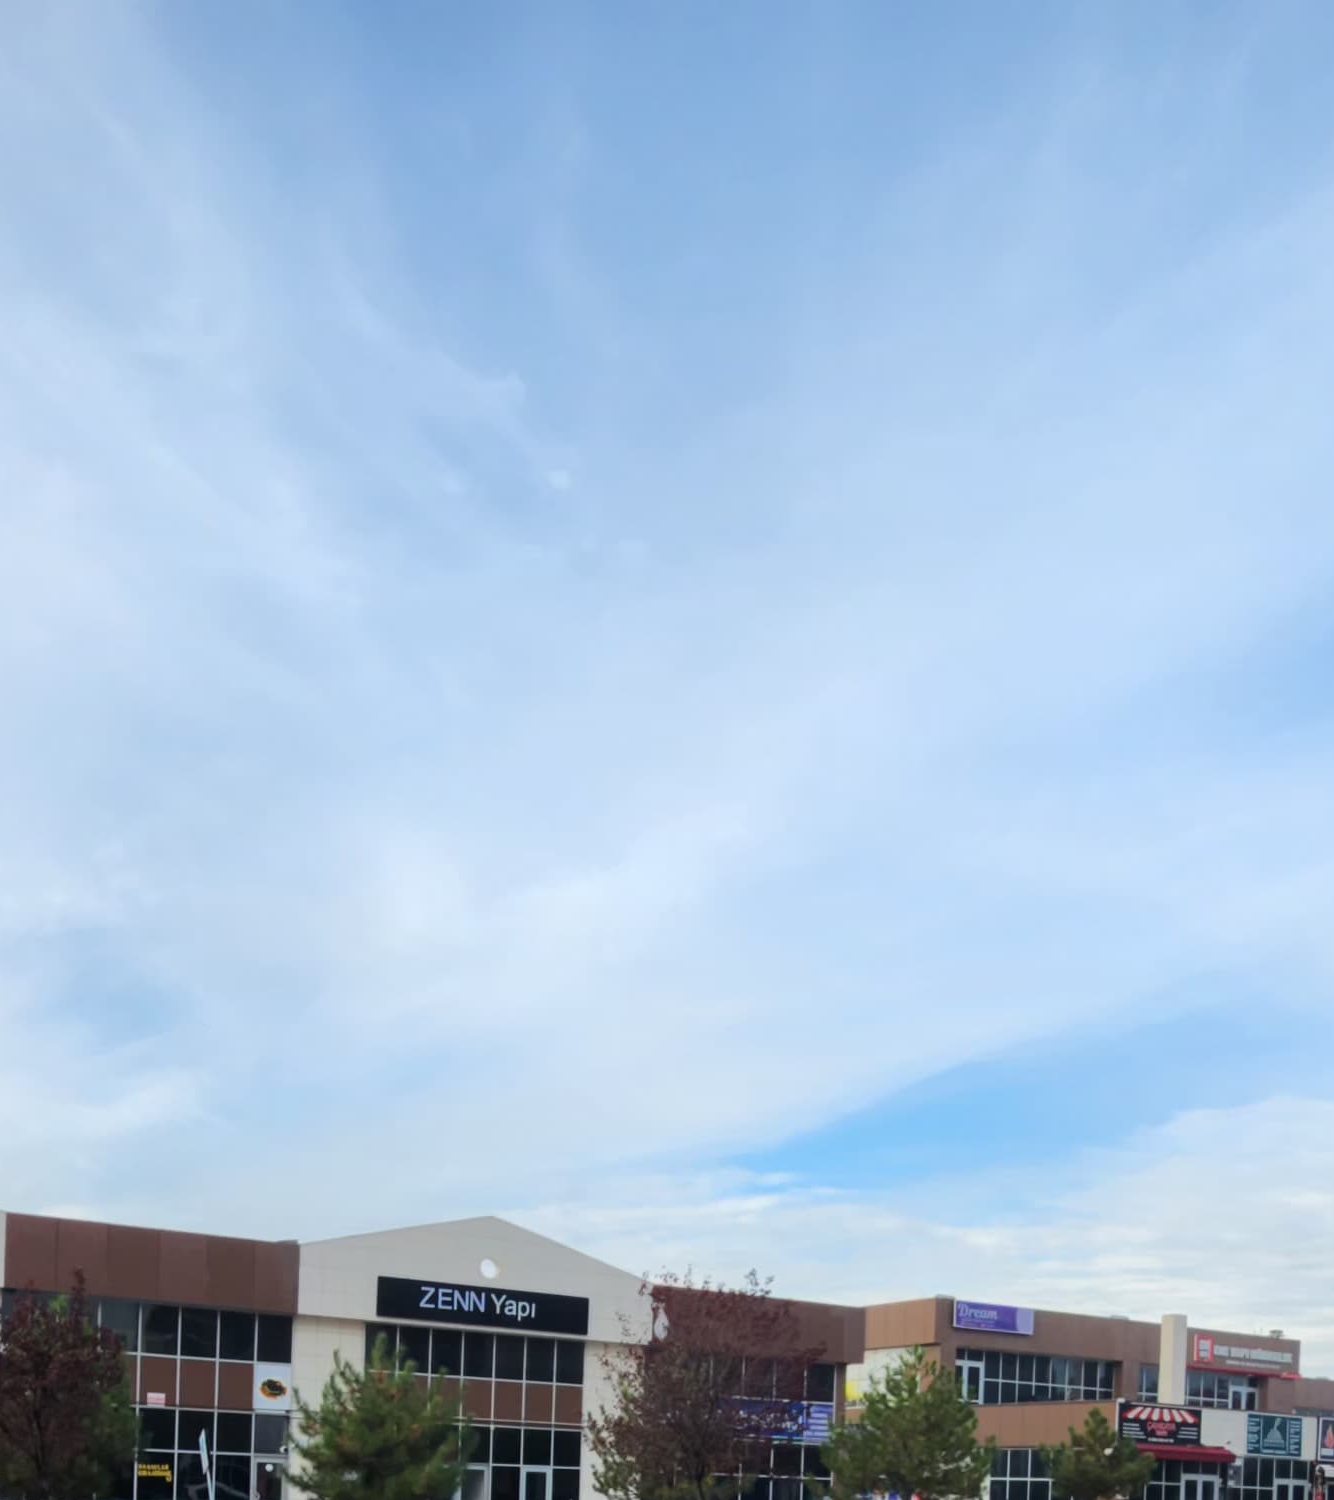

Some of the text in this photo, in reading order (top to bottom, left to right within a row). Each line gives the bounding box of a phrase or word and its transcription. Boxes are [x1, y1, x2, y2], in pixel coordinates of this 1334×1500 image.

[419, 1286, 536, 1321] ZENN Yapı
[958, 1303, 998, 1320] Dream
